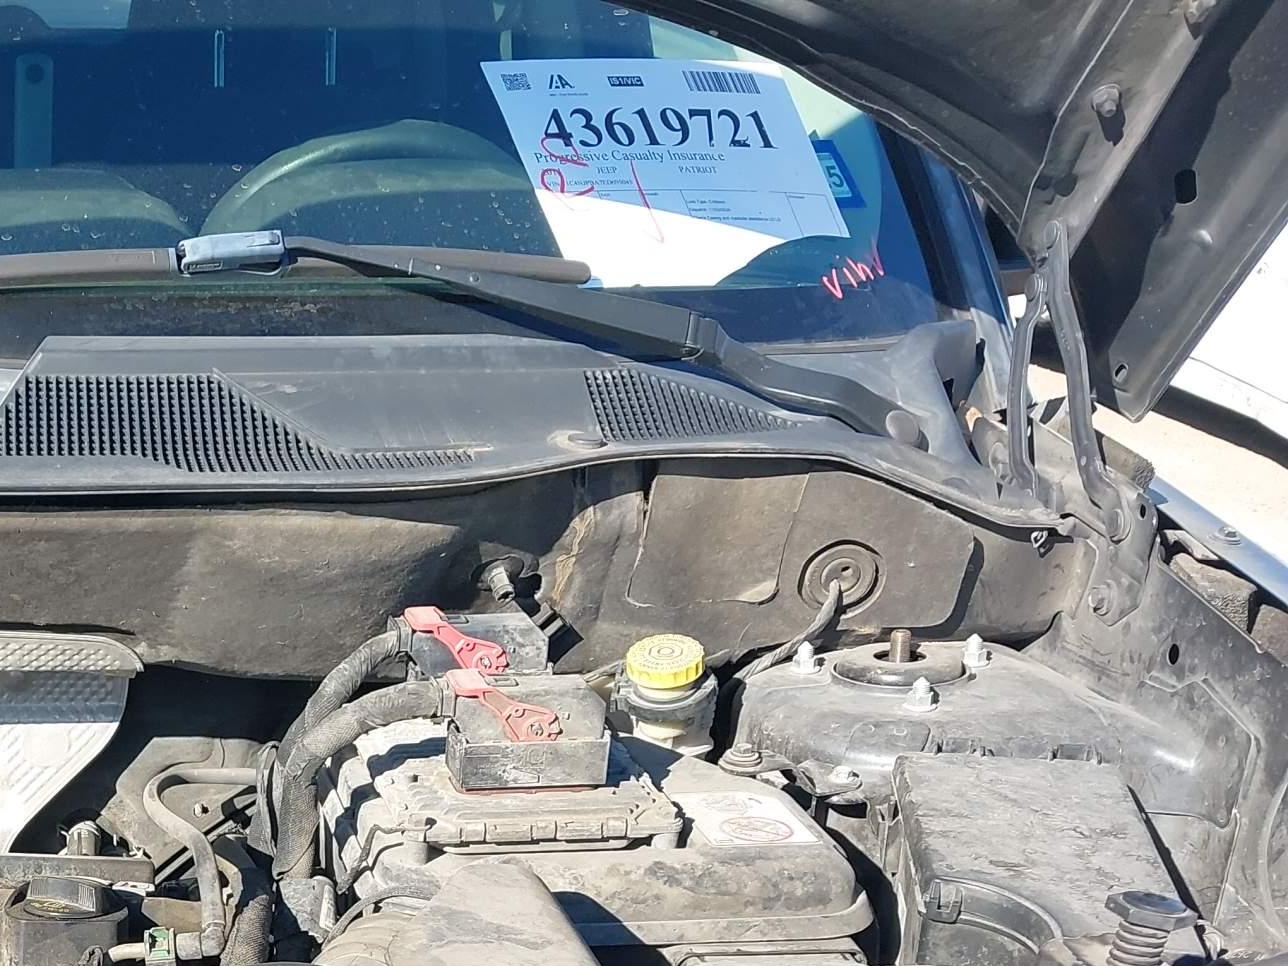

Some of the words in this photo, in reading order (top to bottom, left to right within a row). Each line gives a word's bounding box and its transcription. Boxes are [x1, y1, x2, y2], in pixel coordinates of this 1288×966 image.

[544, 107, 780, 149] 43619721
[534, 150, 609, 166] Progressive
[612, 149, 664, 164] Casualty
[669, 149, 725, 161] Insurance
[597, 166, 617, 174] JEEP
[678, 165, 718, 174] PATRIOT
